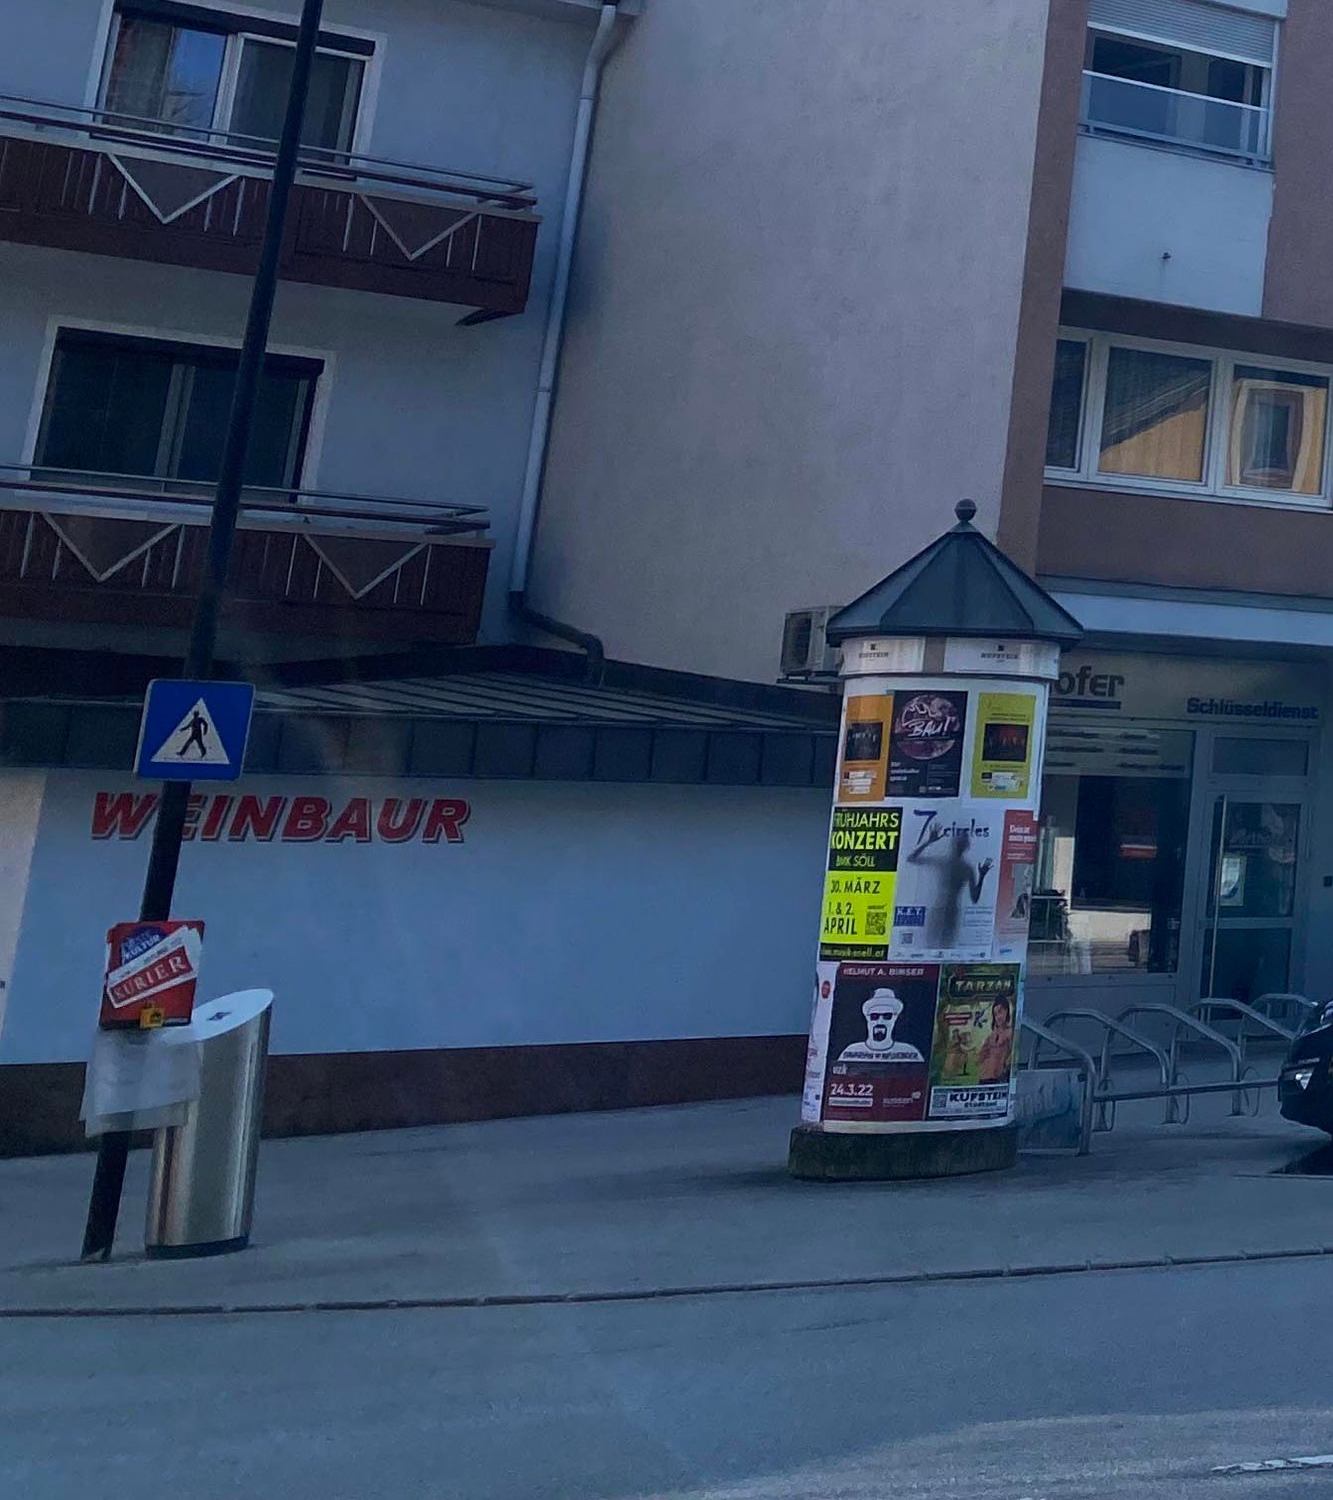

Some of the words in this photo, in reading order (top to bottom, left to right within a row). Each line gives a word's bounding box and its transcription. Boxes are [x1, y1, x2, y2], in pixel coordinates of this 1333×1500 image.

[1050, 665, 1125, 698] ofer
[1186, 697, 1319, 721] Schlüsseldienst
[914, 810, 937, 845] 7
[943, 818, 990, 838] circles
[830, 830, 900, 850] KONZERT
[843, 876, 881, 894] MÄRZ
[823, 916, 858, 935] APRIL
[114, 956, 187, 999] KURIER
[955, 980, 1012, 992] TARZAN
